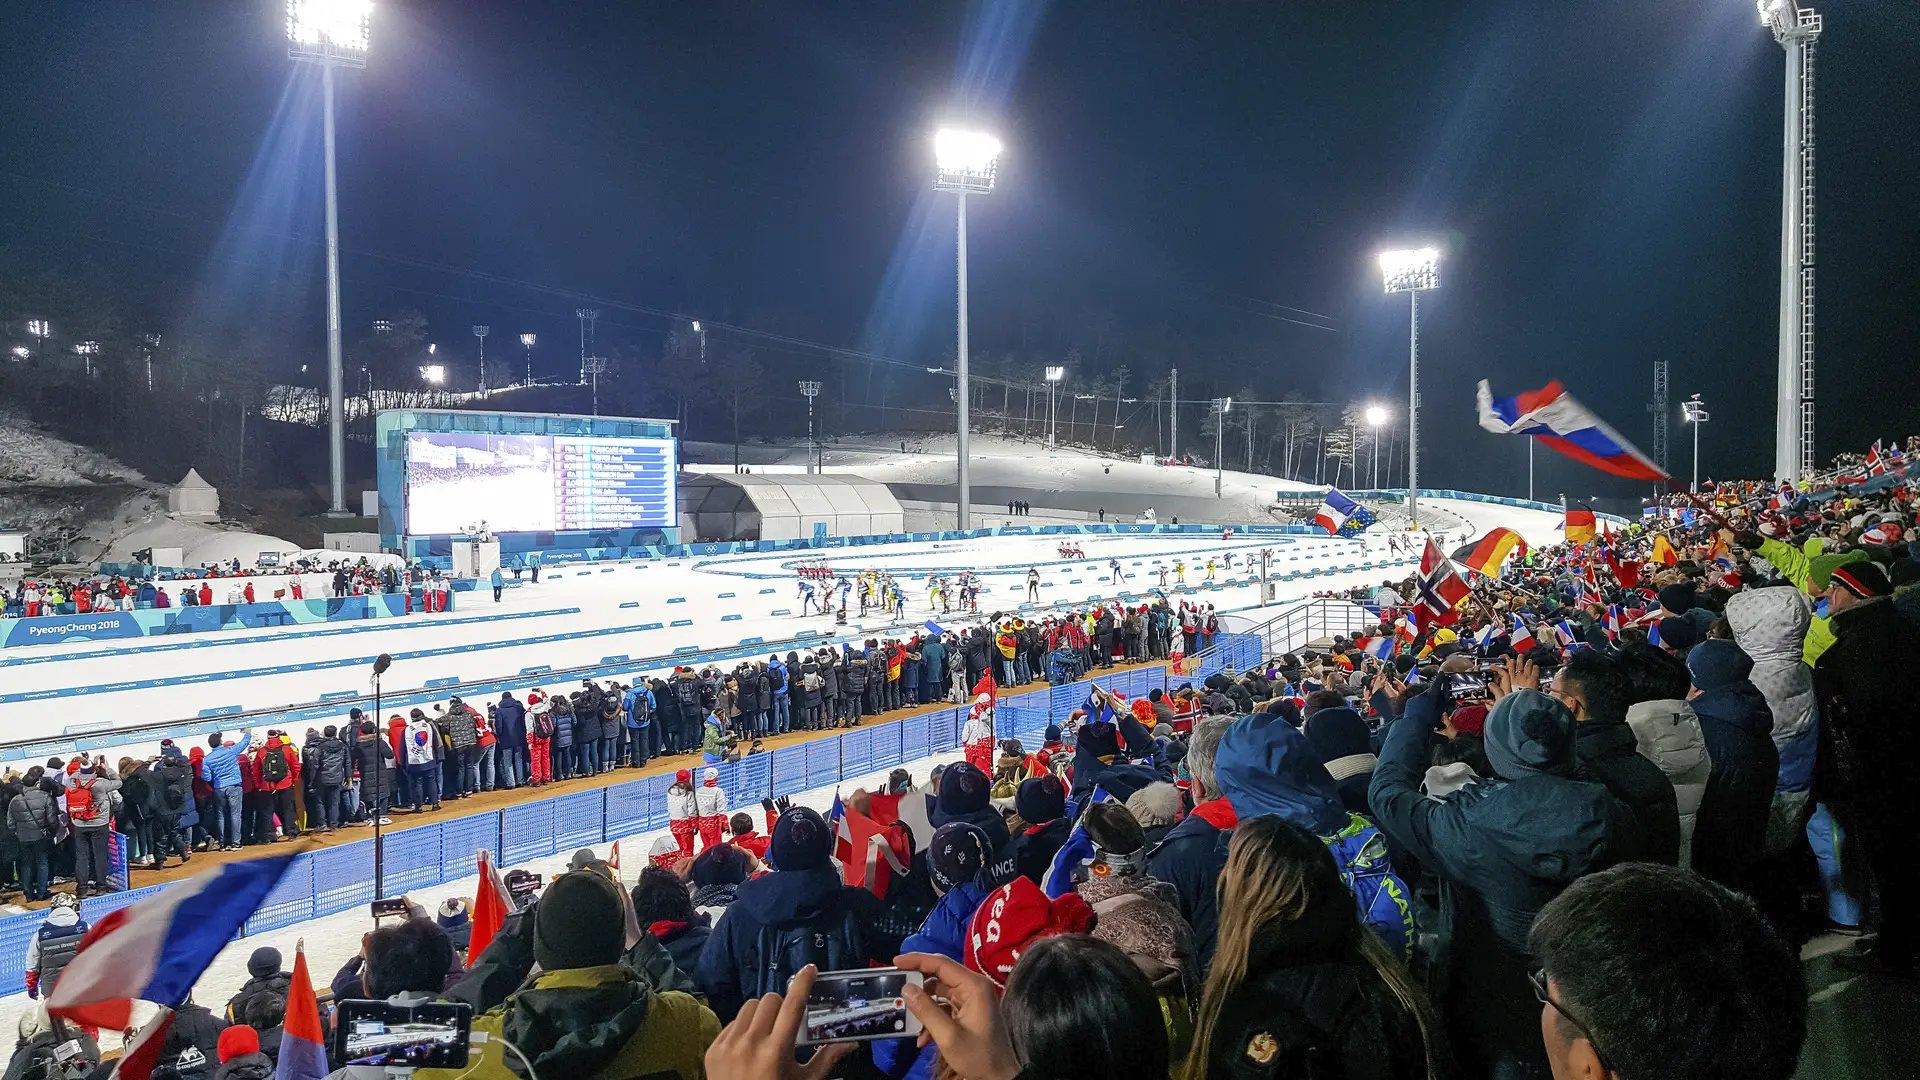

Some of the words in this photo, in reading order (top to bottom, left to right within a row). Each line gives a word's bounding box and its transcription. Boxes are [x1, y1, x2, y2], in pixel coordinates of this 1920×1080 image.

[29, 622, 97, 636] PyeongChang
[98, 620, 120, 630] 2018
[985, 883, 1011, 943] rea
